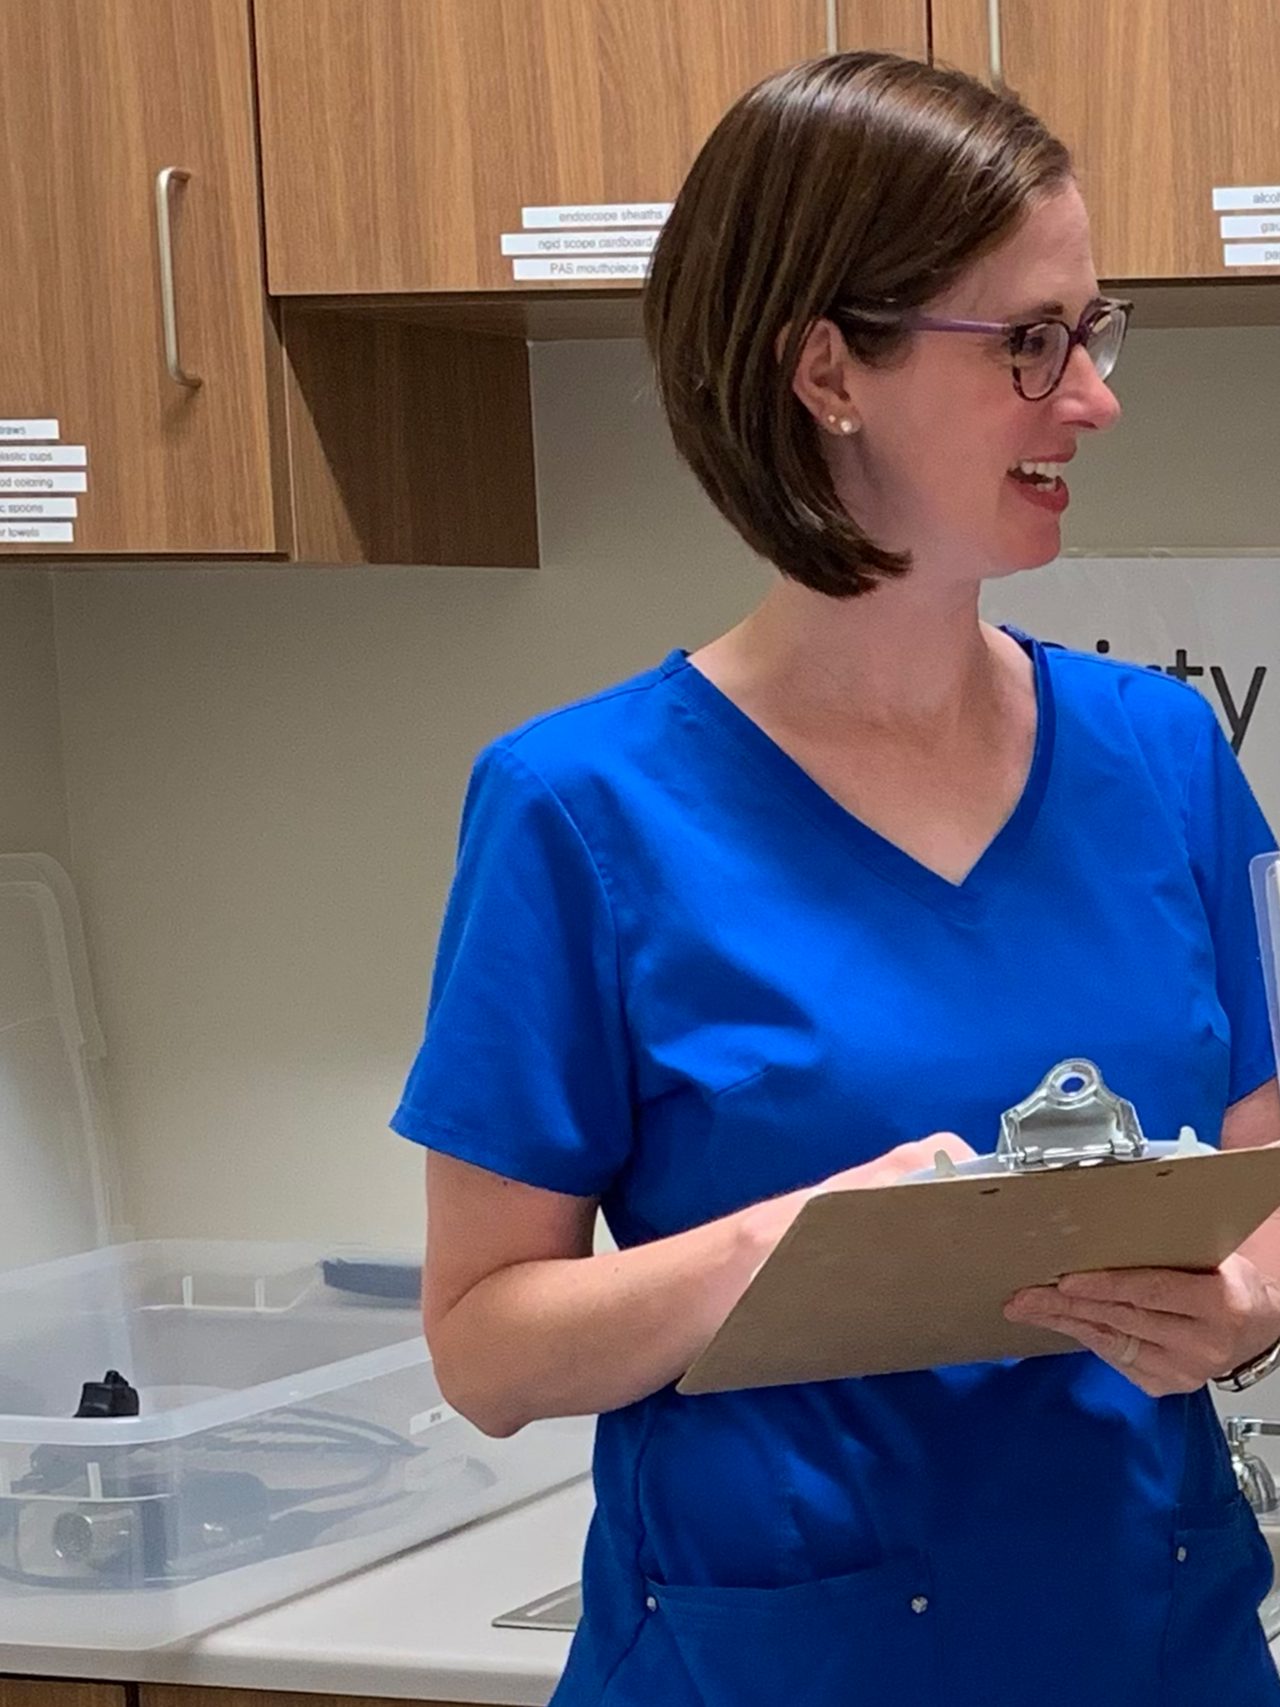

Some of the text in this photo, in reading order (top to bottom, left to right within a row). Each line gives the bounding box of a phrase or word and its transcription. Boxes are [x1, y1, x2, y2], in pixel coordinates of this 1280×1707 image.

[559, 208, 663, 223] endoscope sheaths
[563, 239, 596, 249] scope
[598, 236, 653, 248] cardboard
[550, 262, 574, 274] PAS
